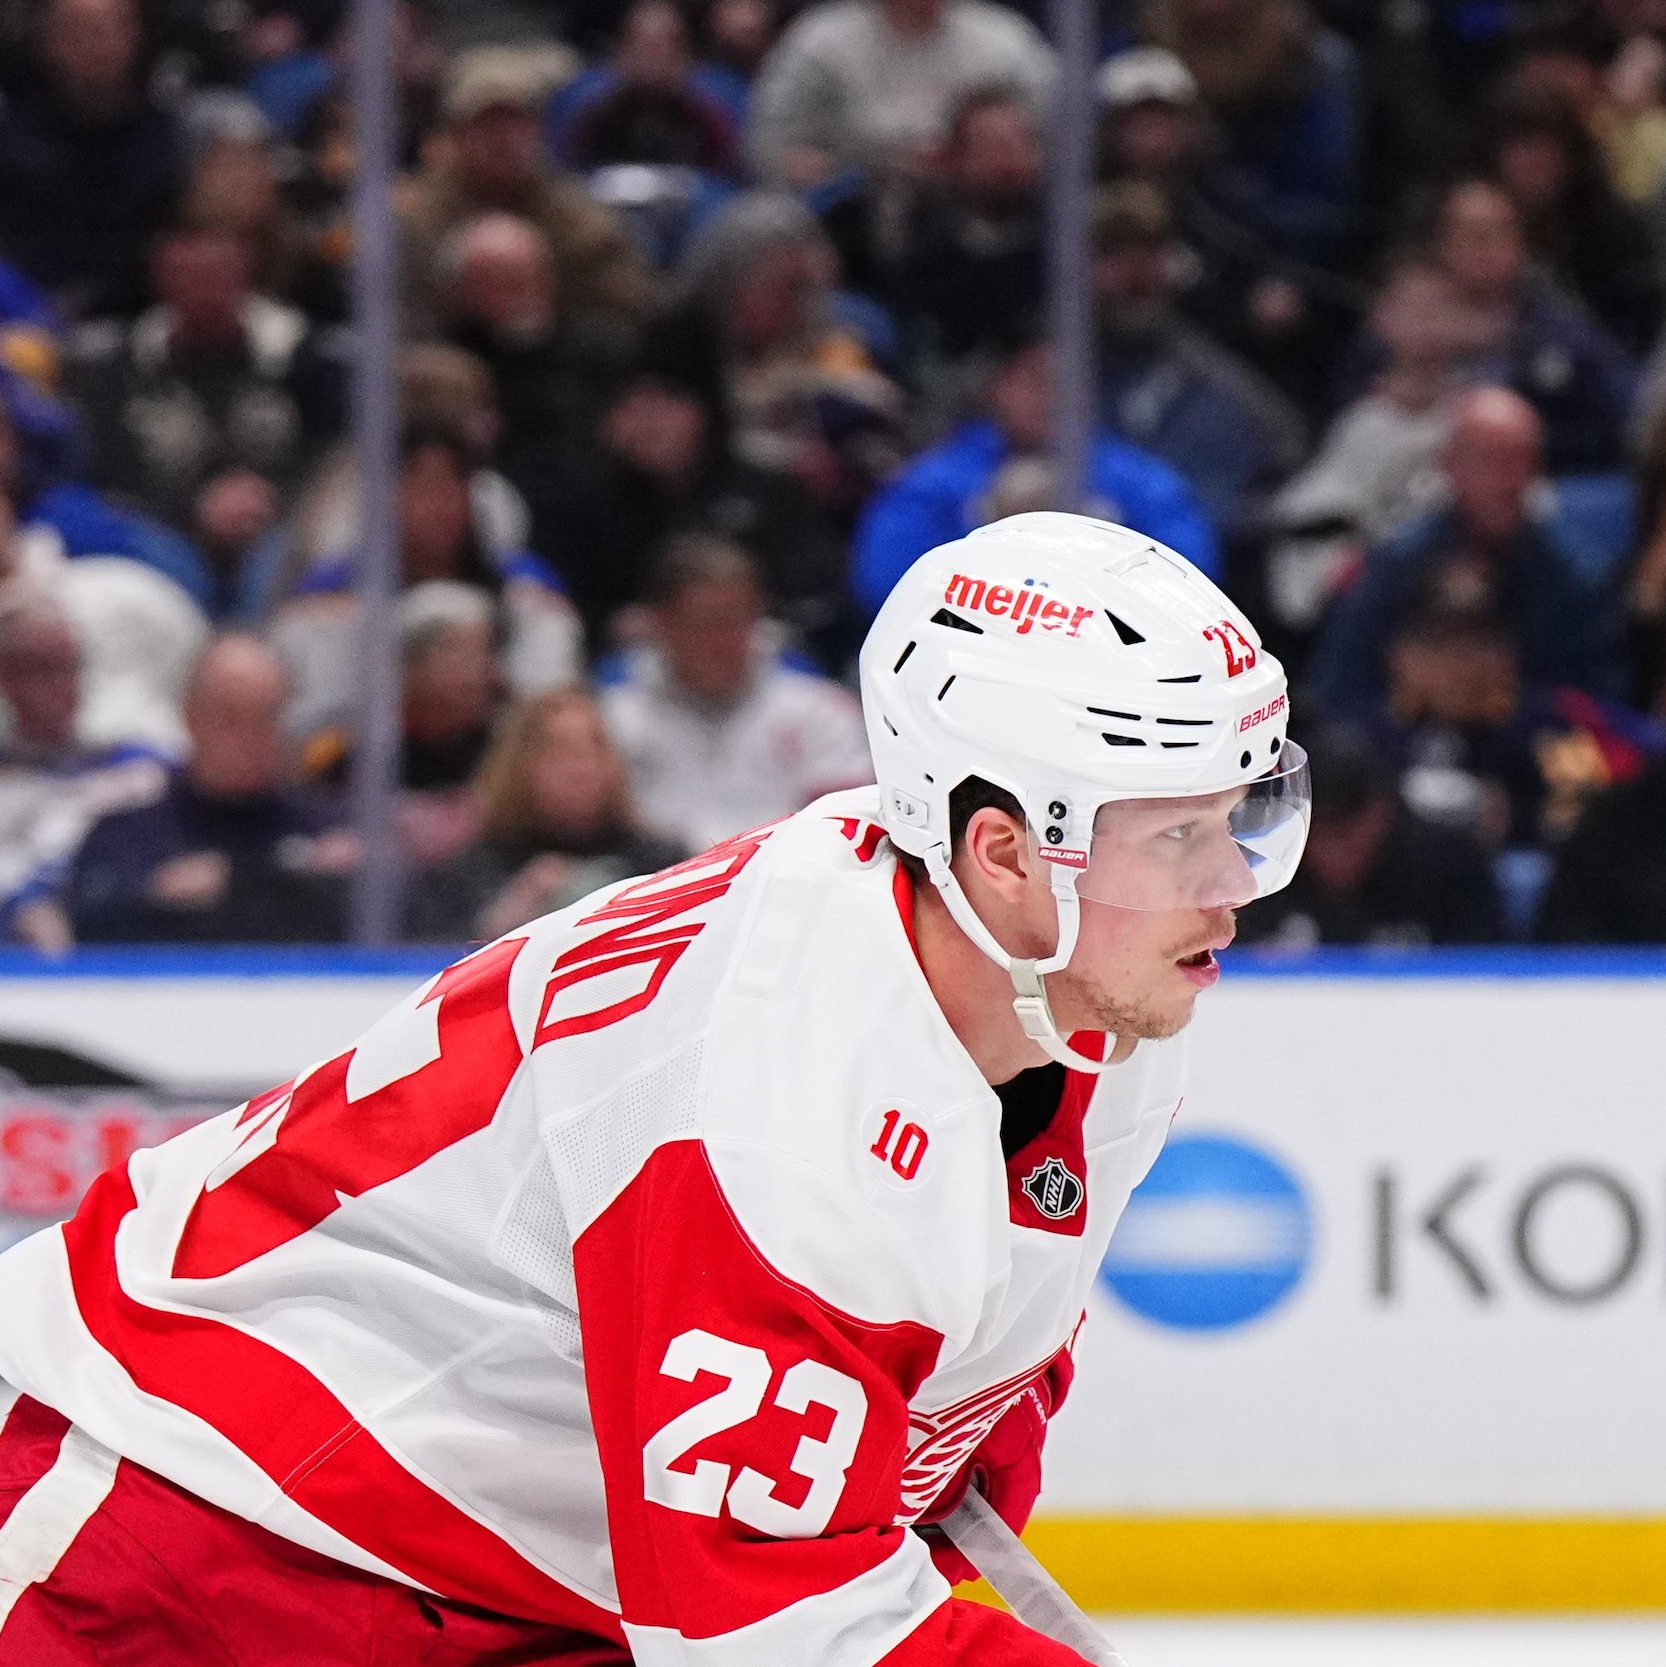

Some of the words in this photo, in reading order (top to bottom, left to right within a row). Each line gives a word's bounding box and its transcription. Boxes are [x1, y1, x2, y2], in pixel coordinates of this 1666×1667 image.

[944, 574, 1095, 638] meijer
[1202, 620, 1256, 678] 23
[870, 1109, 929, 1181] 10
[1046, 1173, 1063, 1212] NHL
[643, 1329, 869, 1539] 23
